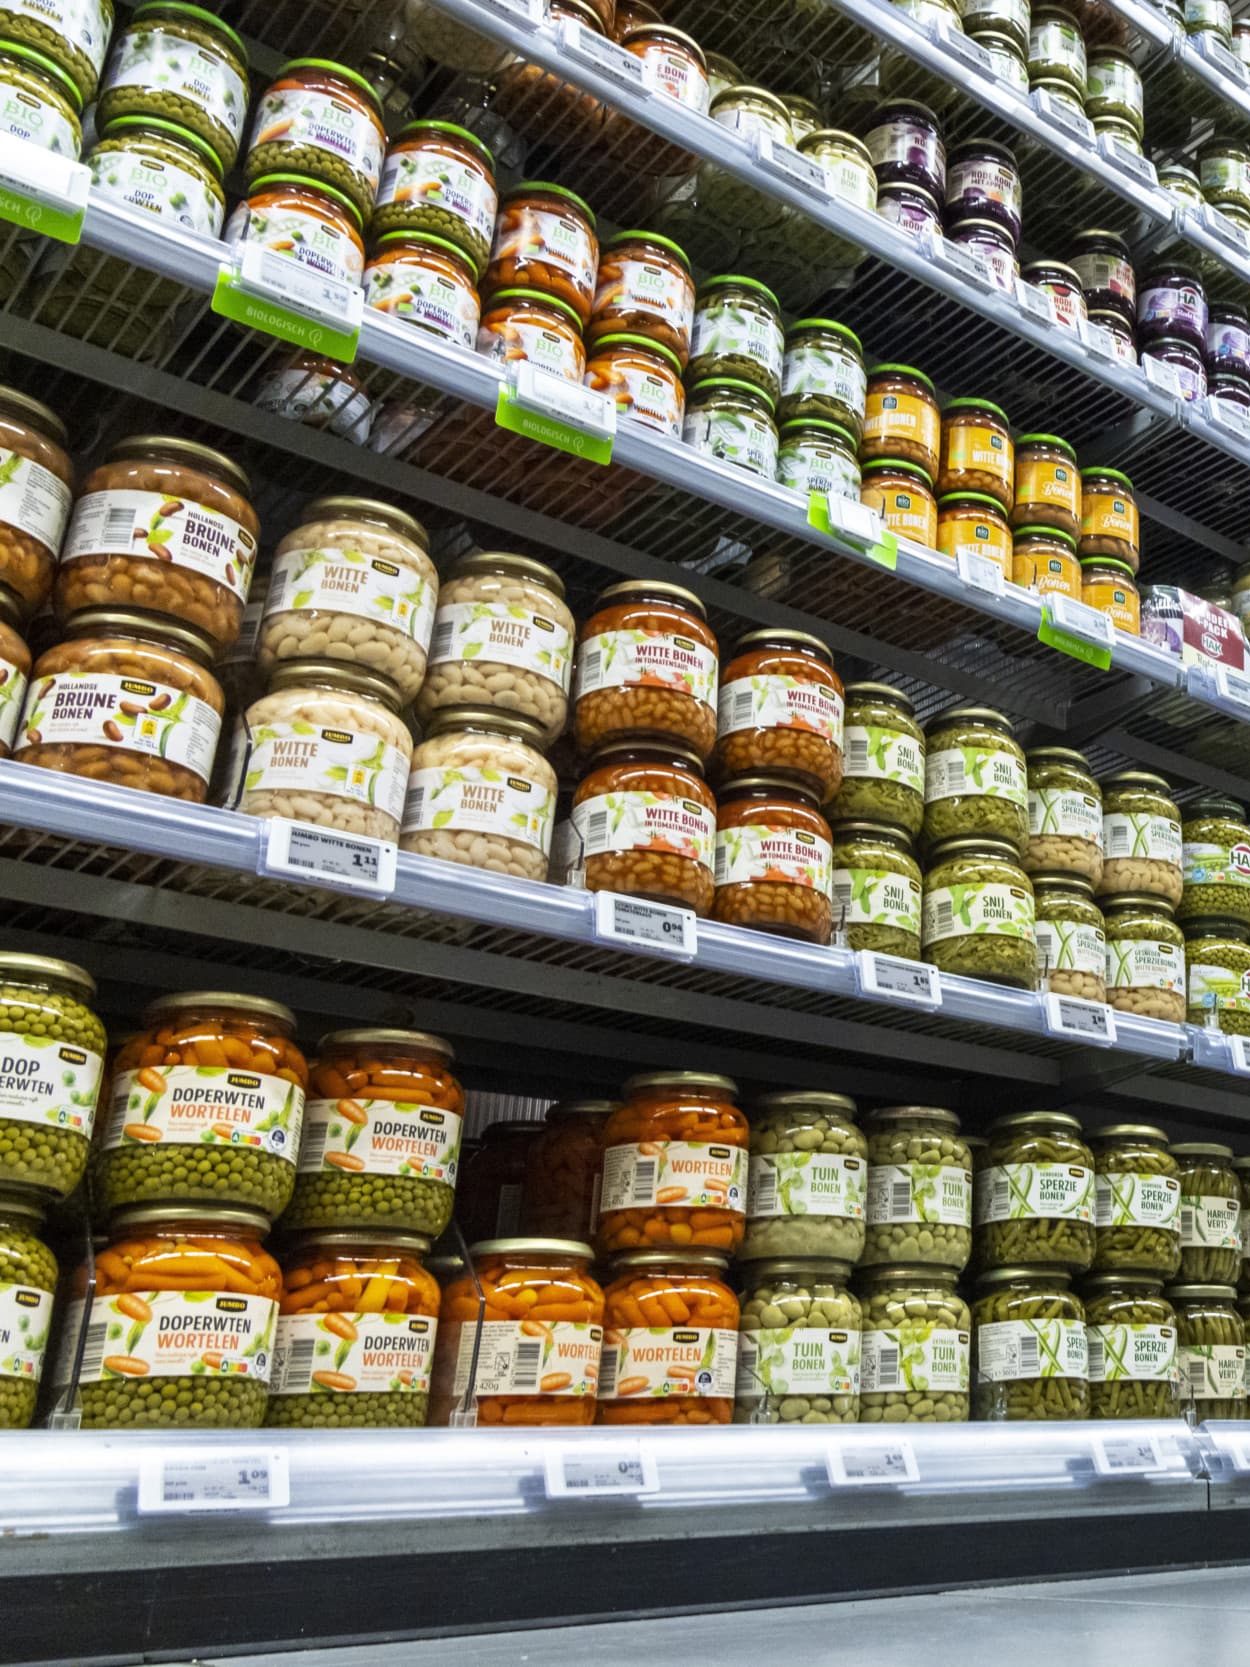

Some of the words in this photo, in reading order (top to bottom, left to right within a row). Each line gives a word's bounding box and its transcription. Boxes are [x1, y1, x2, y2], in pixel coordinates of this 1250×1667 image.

[4, 100, 44, 127] BIO
[323, 107, 354, 130] BIO
[10, 124, 31, 139] DOP
[131, 167, 168, 189] BIO
[135, 190, 155, 202] DOP
[637, 272, 665, 290] BIO
[430, 283, 457, 305] BIO
[246, 306, 305, 337] BIOLOGISCH
[536, 338, 564, 358] BIO
[640, 382, 666, 402] BIO
[522, 419, 570, 445] BIOLOGISCH
[809, 457, 835, 473] BIO
[972, 450, 994, 465] WITTE
[187, 510, 224, 530] HOLLANDSE
[184, 519, 236, 554] BRUINE
[182, 534, 221, 558] BONEN
[324, 565, 368, 584] WITTE
[321, 579, 360, 594] BONEN
[1037, 575, 1071, 592] Bonen
[490, 619, 531, 641] WITTE
[488, 633, 524, 649] BONEN
[1202, 636, 1223, 654] HAK
[635, 643, 672, 660] WITTE
[673, 648, 704, 671] BONEN
[643, 657, 689, 672] TOMATENSAUS
[58, 683, 98, 691] HOLLANDSE
[124, 681, 154, 694] JUMBO
[55, 691, 117, 710] BRUINE
[786, 688, 817, 707] WITTE
[818, 693, 841, 717] BONEN
[52, 707, 93, 720] BONEN
[325, 730, 352, 742] JUMBO
[273, 741, 319, 757] WITTE
[897, 745, 915, 761] SNIJ
[270, 753, 309, 769] BONEN
[897, 757, 920, 774] BONEN
[993, 760, 1012, 777] SNIJ
[993, 773, 1018, 788] BONEN
[462, 784, 505, 803] WITTE
[460, 799, 497, 814] BONEN
[645, 806, 680, 824] WITTE
[680, 811, 709, 835] BONEN
[653, 820, 697, 837] TOMATENSAUS
[292, 830, 319, 842] JUMBO
[320, 836, 344, 848] WITTE
[346, 842, 372, 854] BONEN
[760, 839, 791, 857] WITTE
[791, 843, 823, 862] BONEN
[767, 852, 810, 865] TOMATENSAUS
[884, 884, 905, 901] SNIJ
[883, 899, 910, 913] BONEN
[982, 895, 1005, 910] SNIJ
[982, 908, 1013, 920] BONEN
[1, 1056, 41, 1076] DOP
[0, 1075, 54, 1096] ERWTEN
[231, 1077, 259, 1087] JUMBO
[171, 1087, 265, 1110] DOPERWTEN
[169, 1103, 252, 1123] WORTELEN
[373, 1120, 448, 1144] DOPERWTEN
[371, 1137, 438, 1157] WORTELEN
[671, 1159, 733, 1177] WORTELEN
[811, 1166, 839, 1182] TUIN
[810, 1182, 841, 1194] BONEN
[942, 1182, 963, 1196] TUIN
[1039, 1179, 1077, 1193] SPERZIE
[942, 1197, 964, 1209] BONEN
[1039, 1191, 1065, 1201] BONEN
[1141, 1189, 1172, 1203] SPERZIE
[1141, 1201, 1164, 1211] BONEN
[1206, 1209, 1236, 1221] HARICOTS
[1206, 1219, 1228, 1229] VERTS
[219, 1300, 246, 1311] JUMBO
[159, 1315, 252, 1334] DOPERWTEN
[157, 1333, 240, 1352] WORTELEN
[364, 1335, 430, 1354] DOPERWTEN
[793, 1342, 823, 1357] TUIN
[1134, 1340, 1167, 1353] SPERZIE
[362, 1351, 424, 1368] WORTELEN
[632, 1347, 702, 1363] WORTELEN
[931, 1346, 955, 1361] TUIN
[1134, 1353, 1158, 1362] BONEN
[791, 1357, 825, 1371] BONEN
[931, 1362, 957, 1374] BONEN
[478, 1381, 499, 1392] 420g
